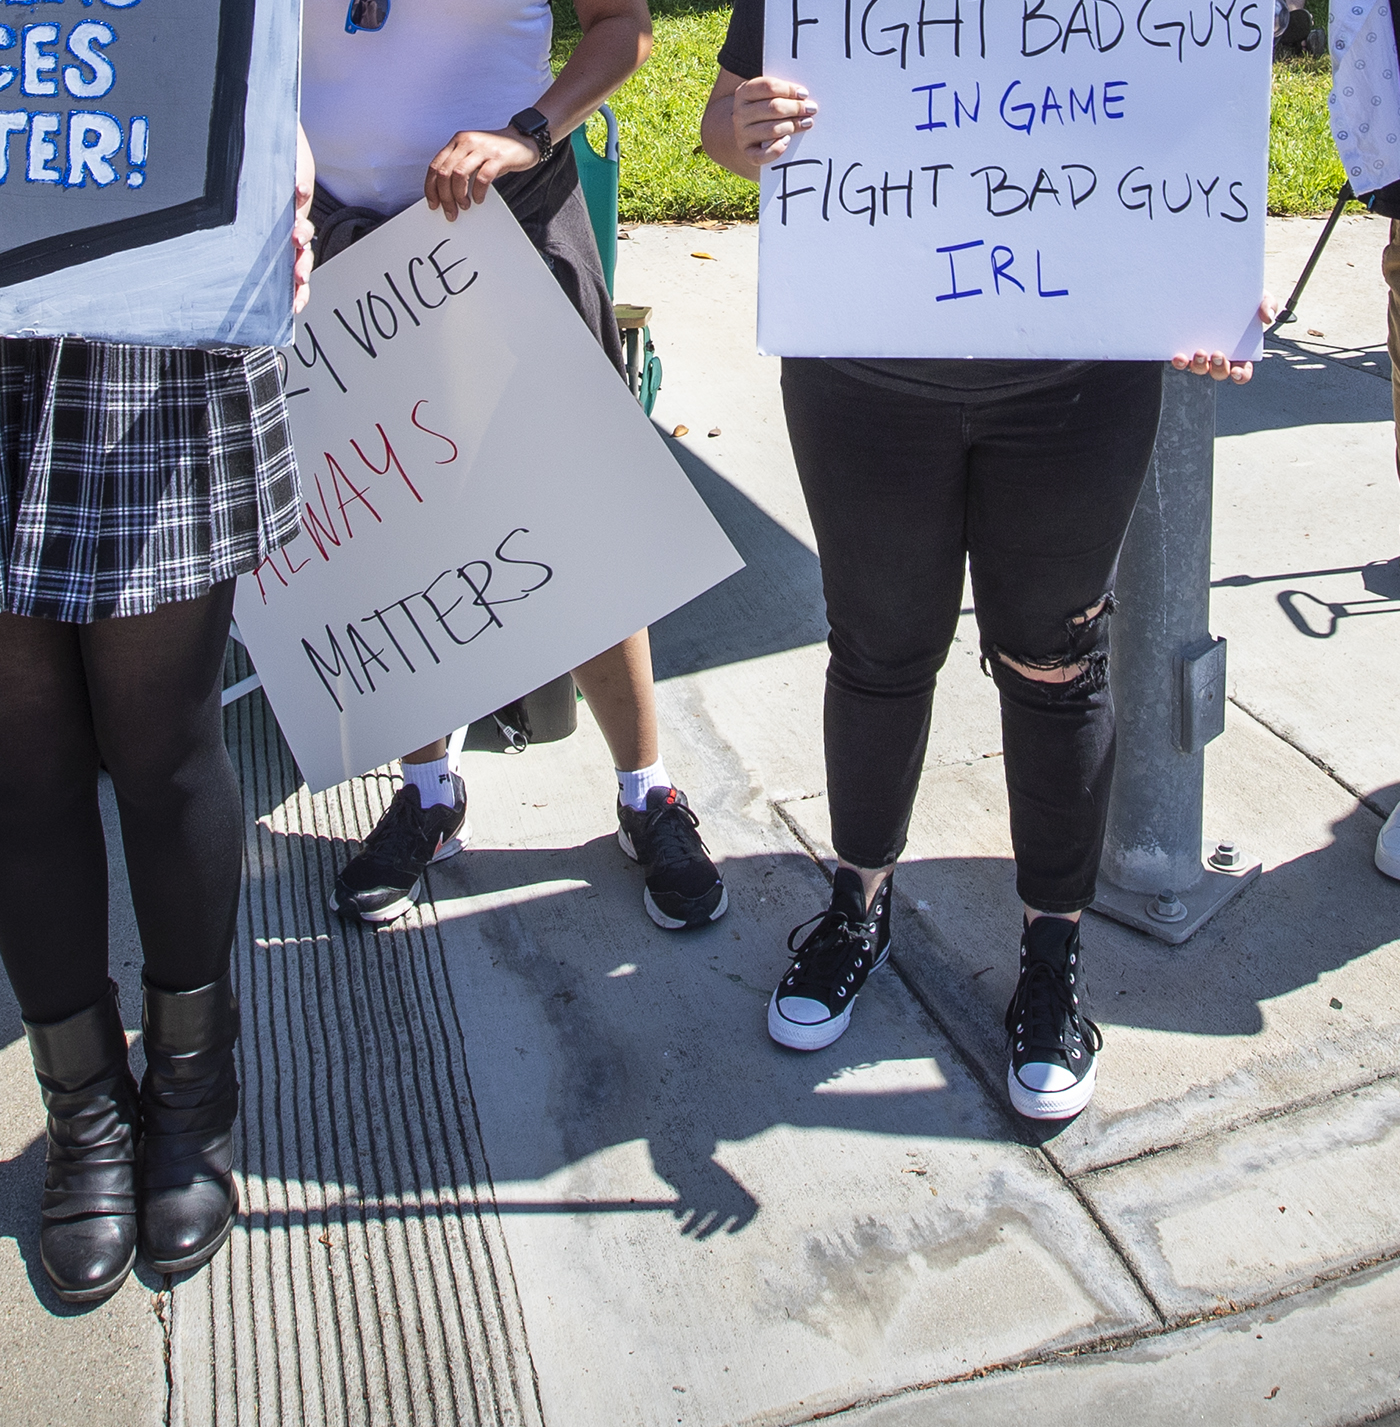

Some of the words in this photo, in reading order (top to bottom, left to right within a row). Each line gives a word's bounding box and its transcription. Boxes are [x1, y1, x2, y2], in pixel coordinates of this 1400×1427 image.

[911, 81, 981, 131] IN
[999, 80, 1129, 135] GAME
[771, 158, 954, 226] FIGHT
[970, 164, 1098, 217] BAD
[1117, 166, 1249, 222] GUYS
[333, 238, 479, 359] VOICE
[935, 239, 1070, 302] IRL
[252, 399, 458, 605] ALWAYS
[301, 528, 553, 713] MATTERS
